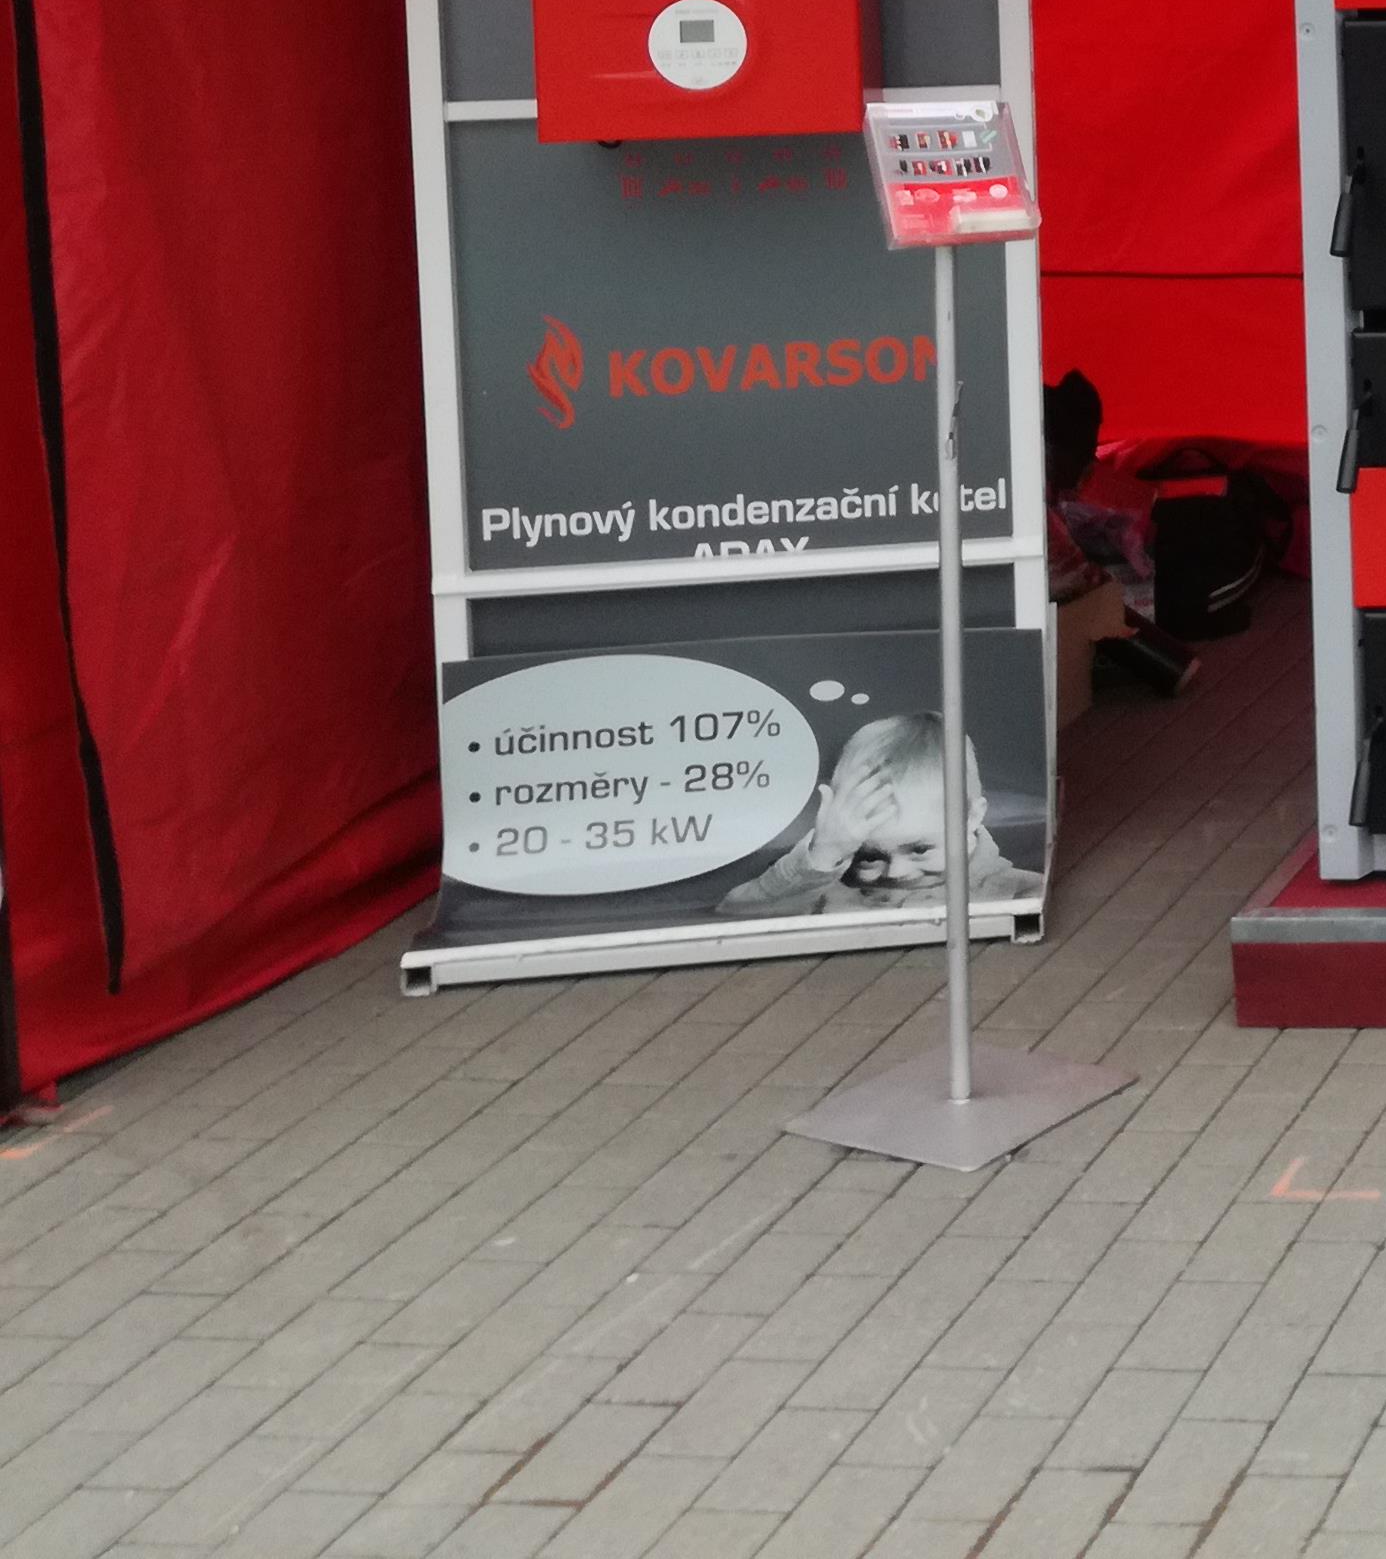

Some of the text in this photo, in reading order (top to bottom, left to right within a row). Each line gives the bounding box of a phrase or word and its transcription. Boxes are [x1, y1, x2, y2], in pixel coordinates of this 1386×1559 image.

[482, 477, 1006, 548] Plynový kondenzační ktel
[494, 708, 782, 756] účinnost 107%
[495, 771, 650, 806] rozměry
[683, 760, 771, 793] 28%
[496, 825, 549, 856] 20
[585, 819, 636, 850] 35
[650, 813, 714, 846] kW
